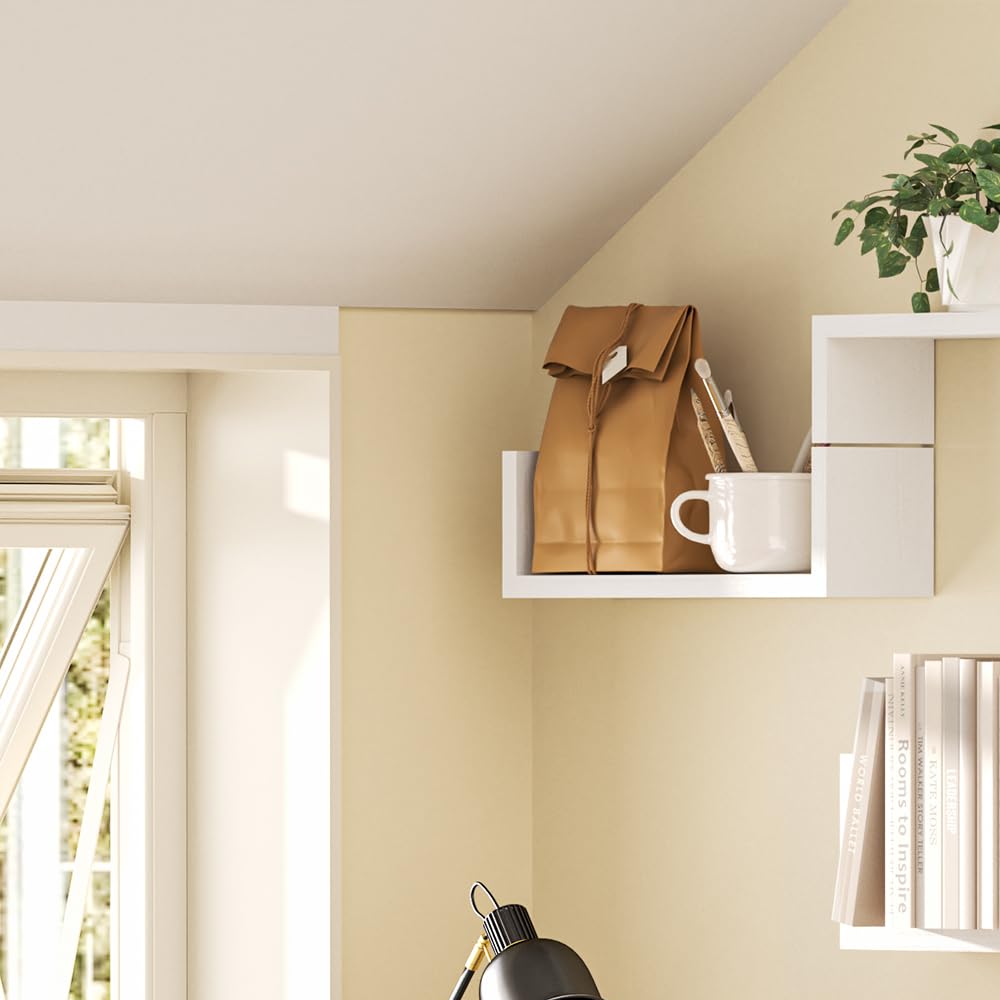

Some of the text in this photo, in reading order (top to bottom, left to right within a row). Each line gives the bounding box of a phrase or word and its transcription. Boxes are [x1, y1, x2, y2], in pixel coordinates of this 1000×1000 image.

[853, 754, 869, 802] WORLD
[929, 760, 938, 800] KATE
[945, 769, 957, 835] LEADERSHIP
[895, 740, 911, 913] Rooms to Inspire
[929, 804, 938, 846] MOSS
